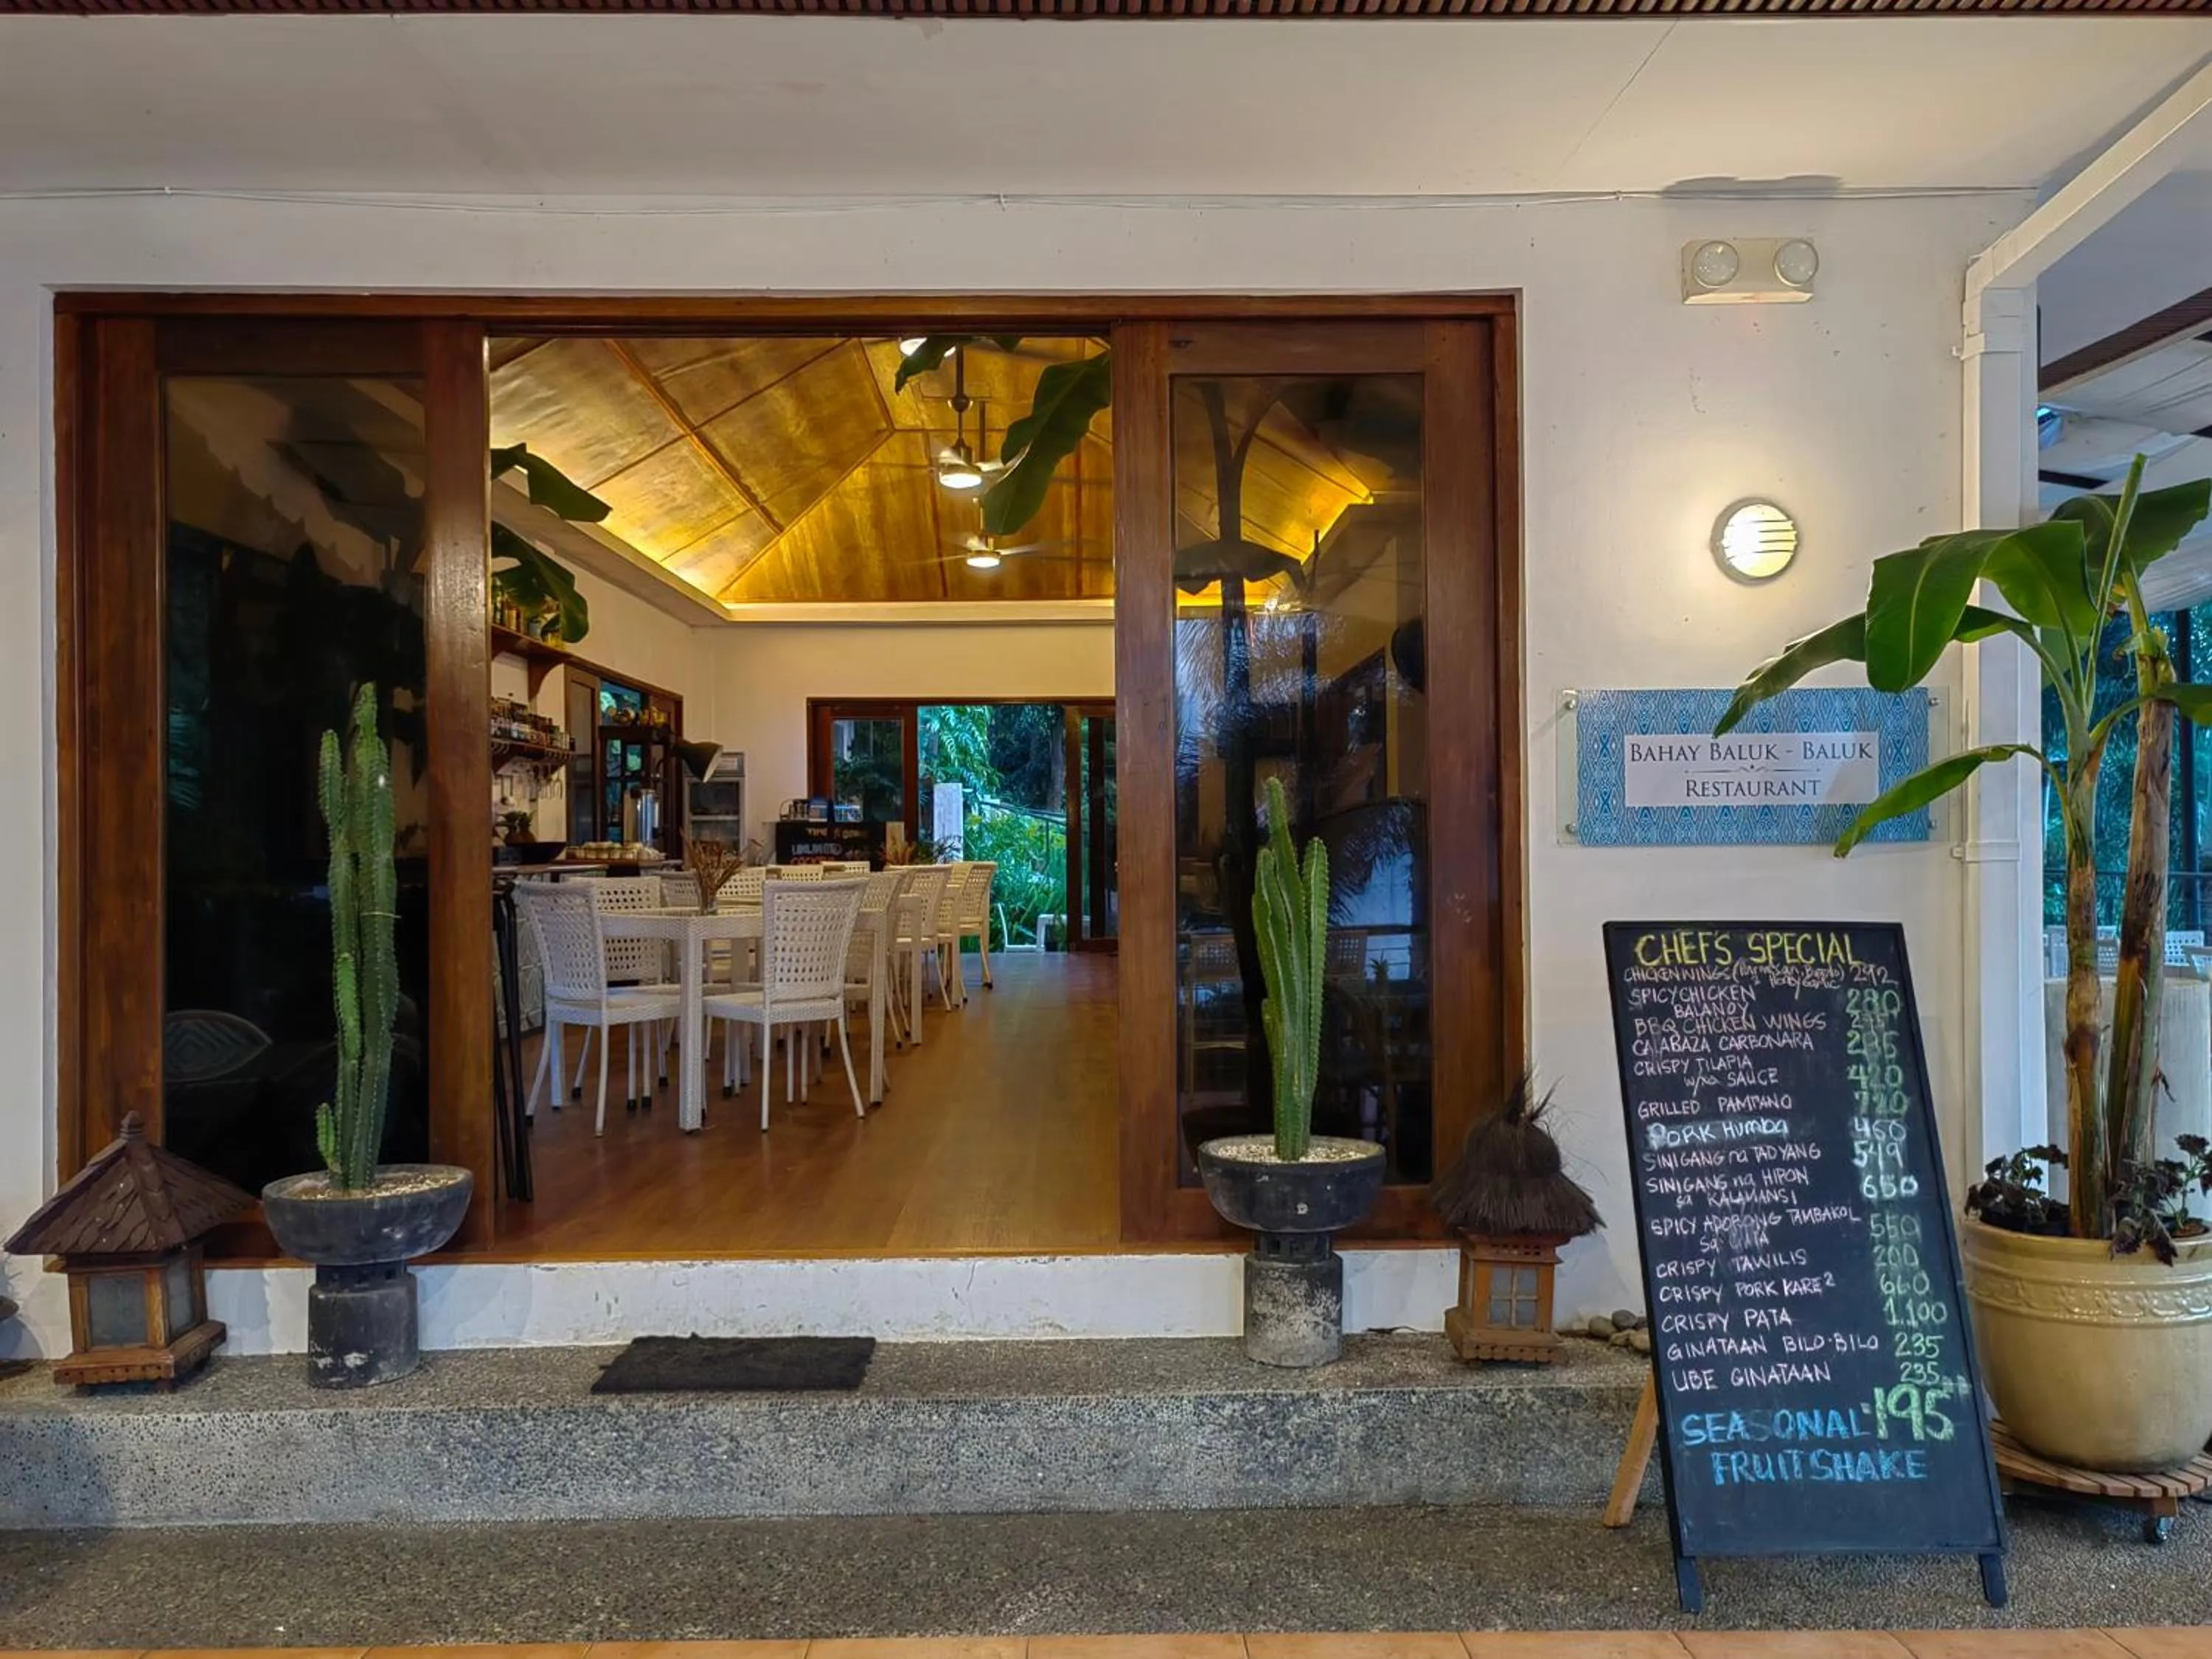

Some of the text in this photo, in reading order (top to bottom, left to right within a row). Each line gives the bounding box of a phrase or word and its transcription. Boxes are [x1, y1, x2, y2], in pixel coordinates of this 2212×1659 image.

[1630, 742, 1700, 763] BAHAY
[1710, 742, 1779, 761] BALUK
[1803, 740, 1874, 760] BALUK
[1686, 779, 1822, 798] RESTAURANT
[1634, 931, 1863, 966] CHEF'S SPECIAL
[1634, 1018, 1679, 1037] BBQ
[1683, 1015, 1756, 1034] CHICKEN
[1762, 1012, 1827, 1031] WINGS
[1719, 1032, 1815, 1051] CARBONARA
[1633, 1058, 1689, 1076] CRISPY
[1696, 1054, 1753, 1071] TILAPIA
[1727, 1068, 1778, 1087] SAUCE
[1638, 1099, 1701, 1119] GRILLED
[1718, 1093, 1792, 1113] PAMPANO
[1643, 1150, 1725, 1171] SINIGANG
[1729, 1150, 1748, 1163] na
[1733, 1174, 1755, 1186] na
[1761, 1166, 1809, 1186] HIPON
[1675, 1194, 1693, 1208] sa
[1651, 1217, 1697, 1236] SPICY
[1656, 1258, 1716, 1278] CRISPY
[1733, 1249, 1807, 1272] TAWILIS
[1659, 1285, 1723, 1304] CRISPY
[1735, 1281, 1779, 1298] PORK
[1661, 1312, 1730, 1334] CRISPY
[1745, 1307, 1792, 1327] PATA
[1667, 1337, 1767, 1361] GINATAAN
[1894, 1332, 1944, 1358] 235
[1672, 1368, 1719, 1392] UBE
[1731, 1362, 1832, 1388] GINATAAN
[1899, 1361, 1941, 1386] 235
[1680, 1408, 1871, 1445] SEASONAL
